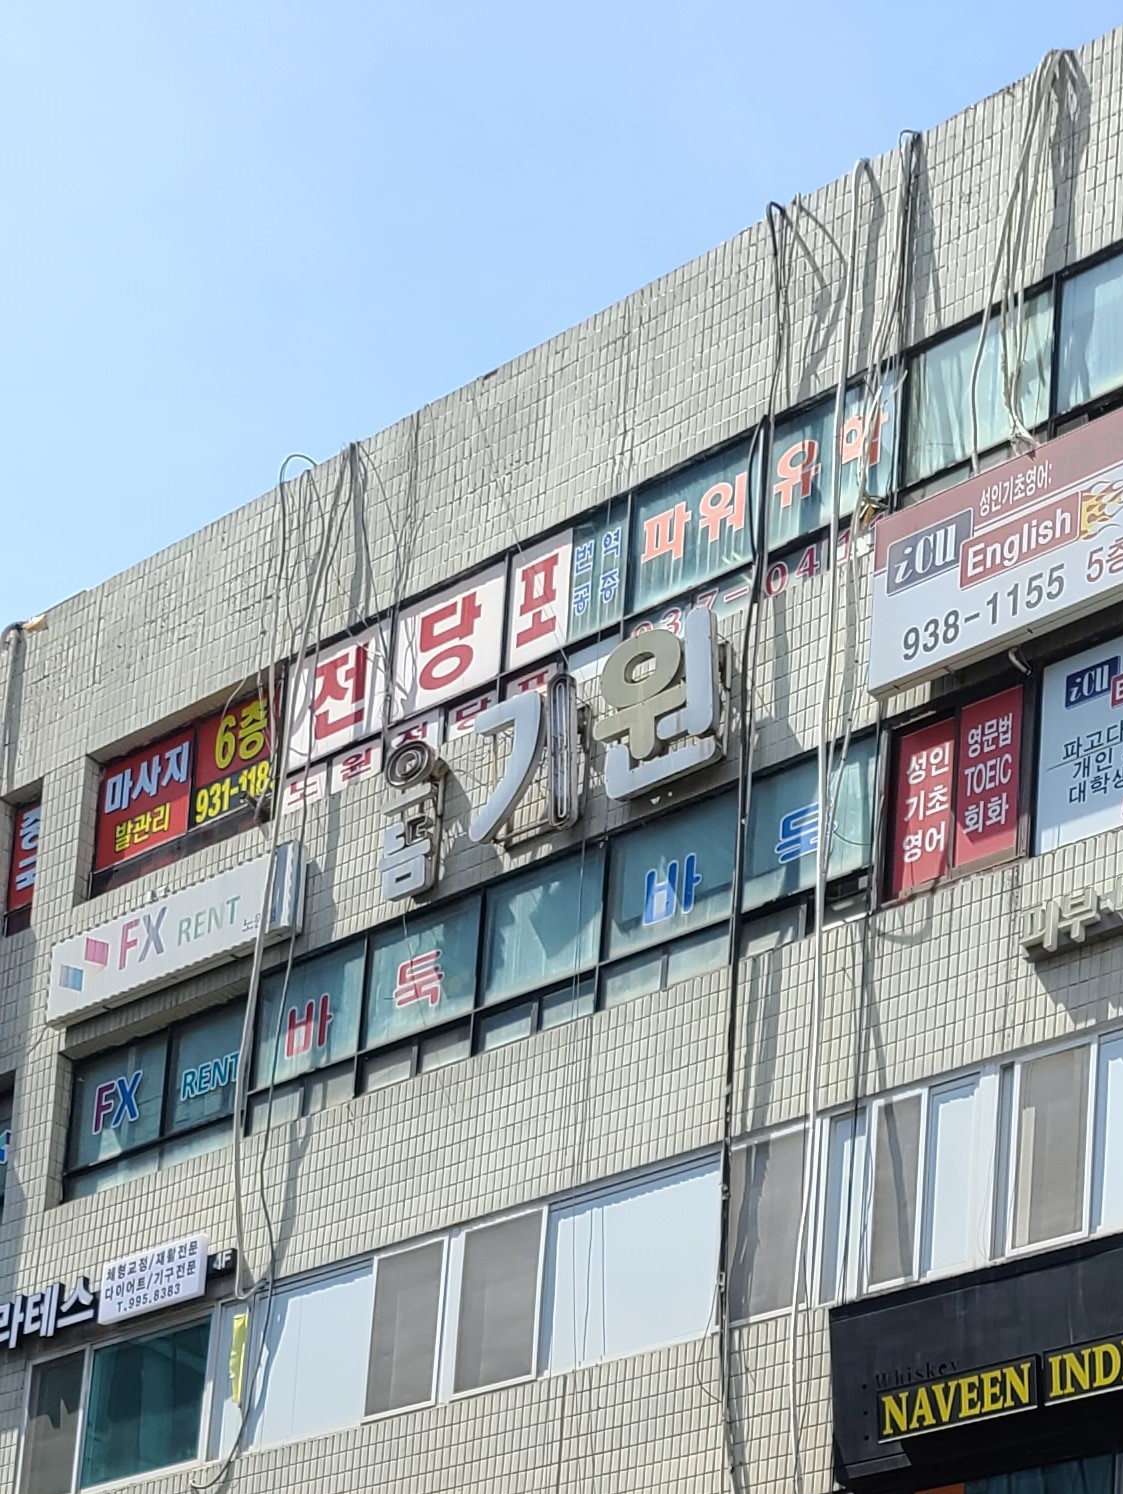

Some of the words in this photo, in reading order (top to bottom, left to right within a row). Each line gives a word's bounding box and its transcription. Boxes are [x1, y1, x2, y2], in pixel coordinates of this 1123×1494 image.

[967, 509, 1072, 577] English
[903, 563, 1065, 661] 938-1155
[314, 546, 566, 741] 전당포
[215, 698, 268, 769] 6층
[467, 607, 726, 843] 기원
[966, 712, 1013, 759] 영문법
[104, 741, 190, 814] 마사지
[905, 743, 951, 785] 성인
[964, 753, 1013, 797] TOEIC
[1073, 748, 1113, 779] 개인
[115, 803, 171, 852] 발관리
[904, 785, 949, 823] 기초
[963, 792, 1010, 836] 회화
[902, 824, 947, 863] 영어
[119, 906, 168, 970] FX
[177, 896, 241, 946] RENT
[92, 1069, 144, 1135] FX
[180, 1051, 242, 1101] RENT
[212, 1250, 232, 1270] 4F
[882, 1362, 1031, 1435] NAVEEN
